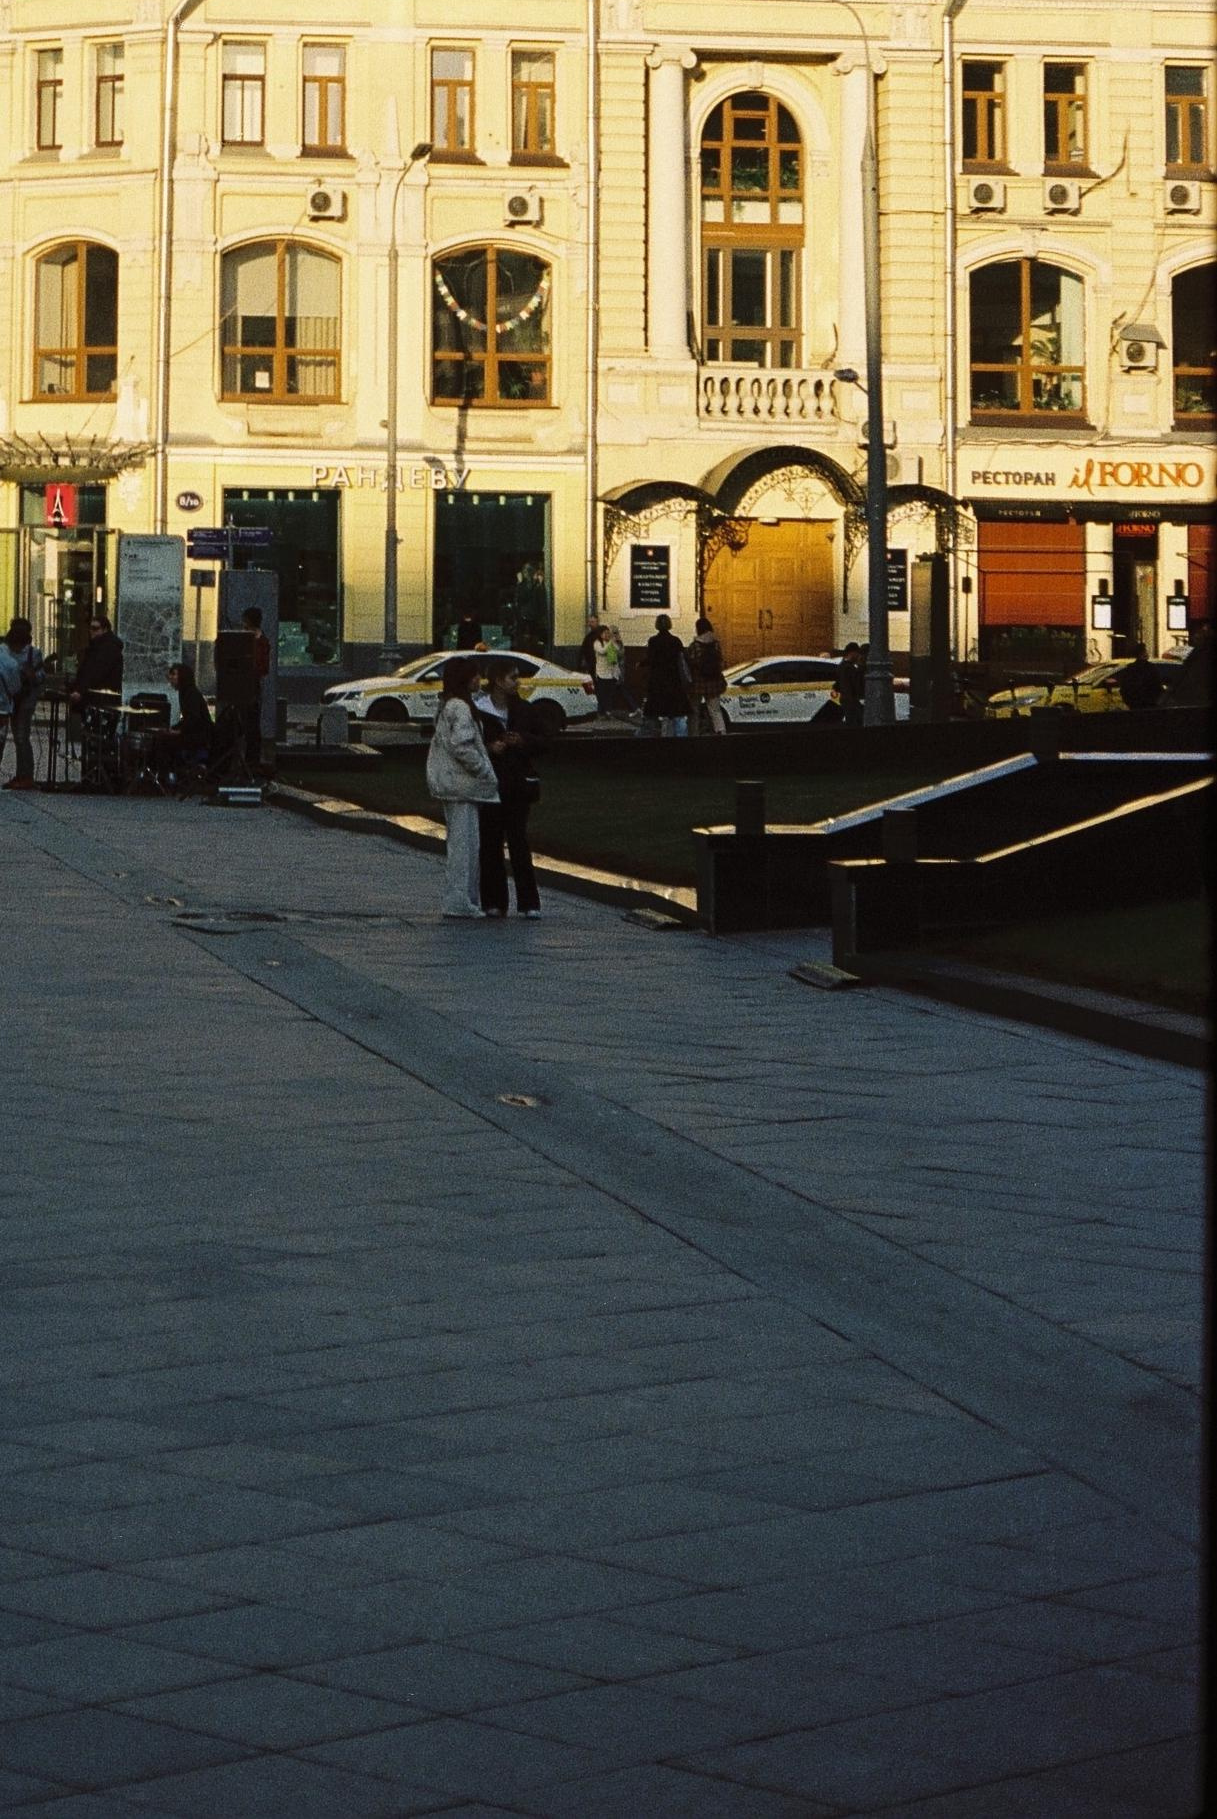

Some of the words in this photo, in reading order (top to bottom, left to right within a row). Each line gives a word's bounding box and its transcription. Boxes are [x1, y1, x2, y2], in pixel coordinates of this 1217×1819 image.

[312, 466, 471, 491] РАНДЕВУ
[971, 470, 1056, 486] РЕСТОРАН
[1097, 461, 1205, 488] FORNO
